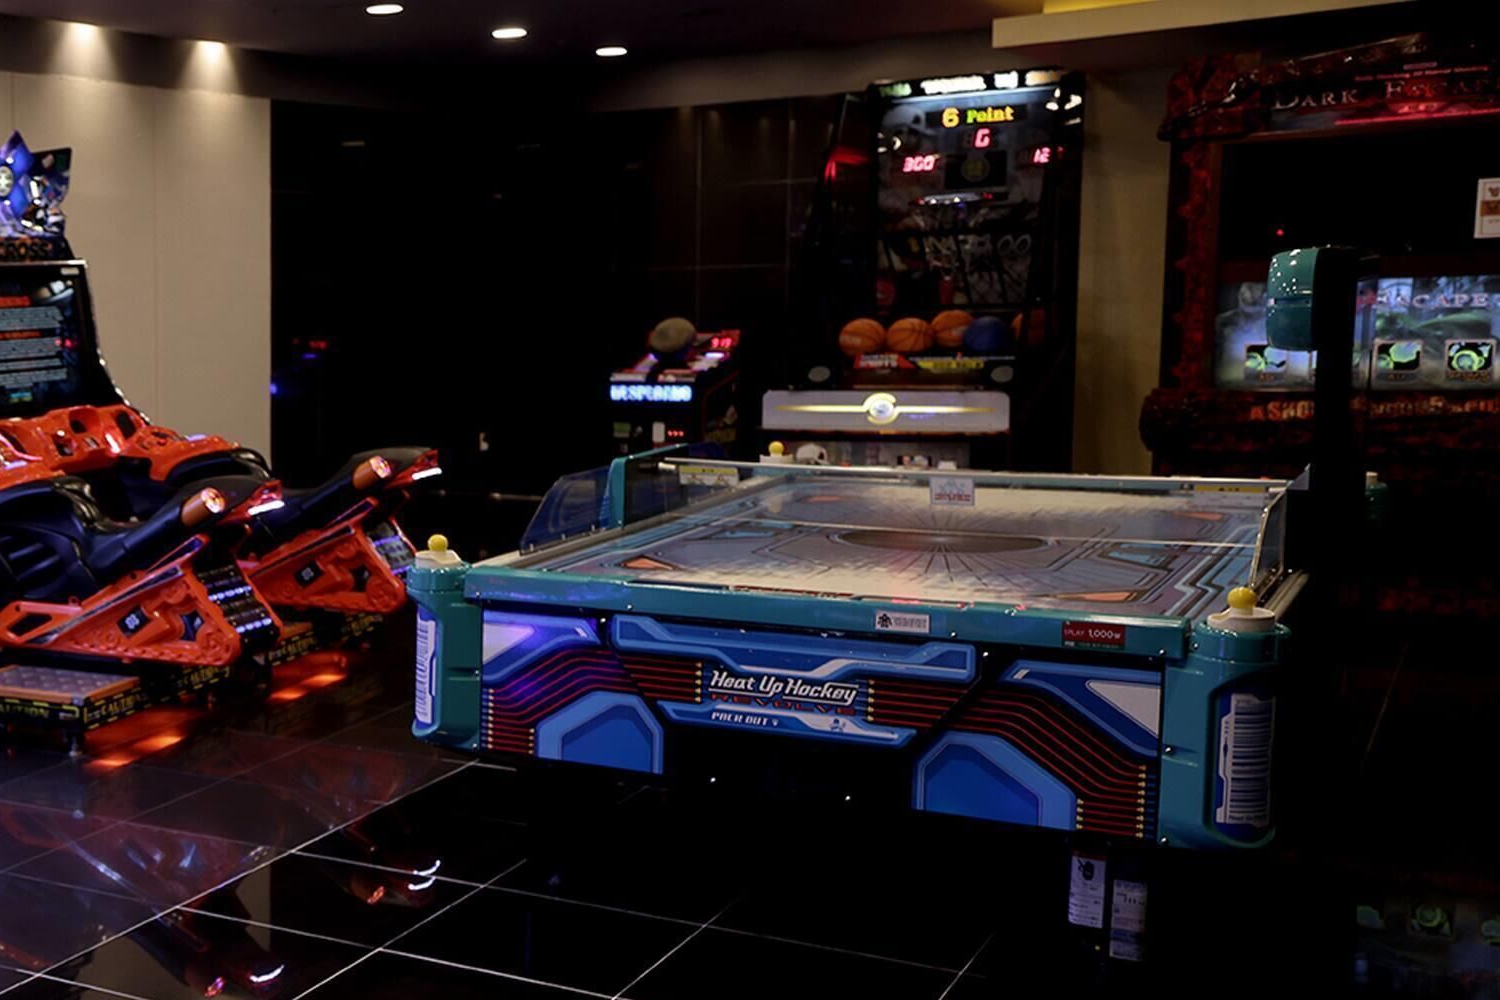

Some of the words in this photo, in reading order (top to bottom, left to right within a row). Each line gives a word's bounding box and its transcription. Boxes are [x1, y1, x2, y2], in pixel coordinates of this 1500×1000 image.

[942, 107, 960, 128] 6
[966, 106, 1015, 124] Point
[710, 669, 756, 691] Heat
[759, 675, 785, 697] Up
[785, 677, 860, 706] Hockey
